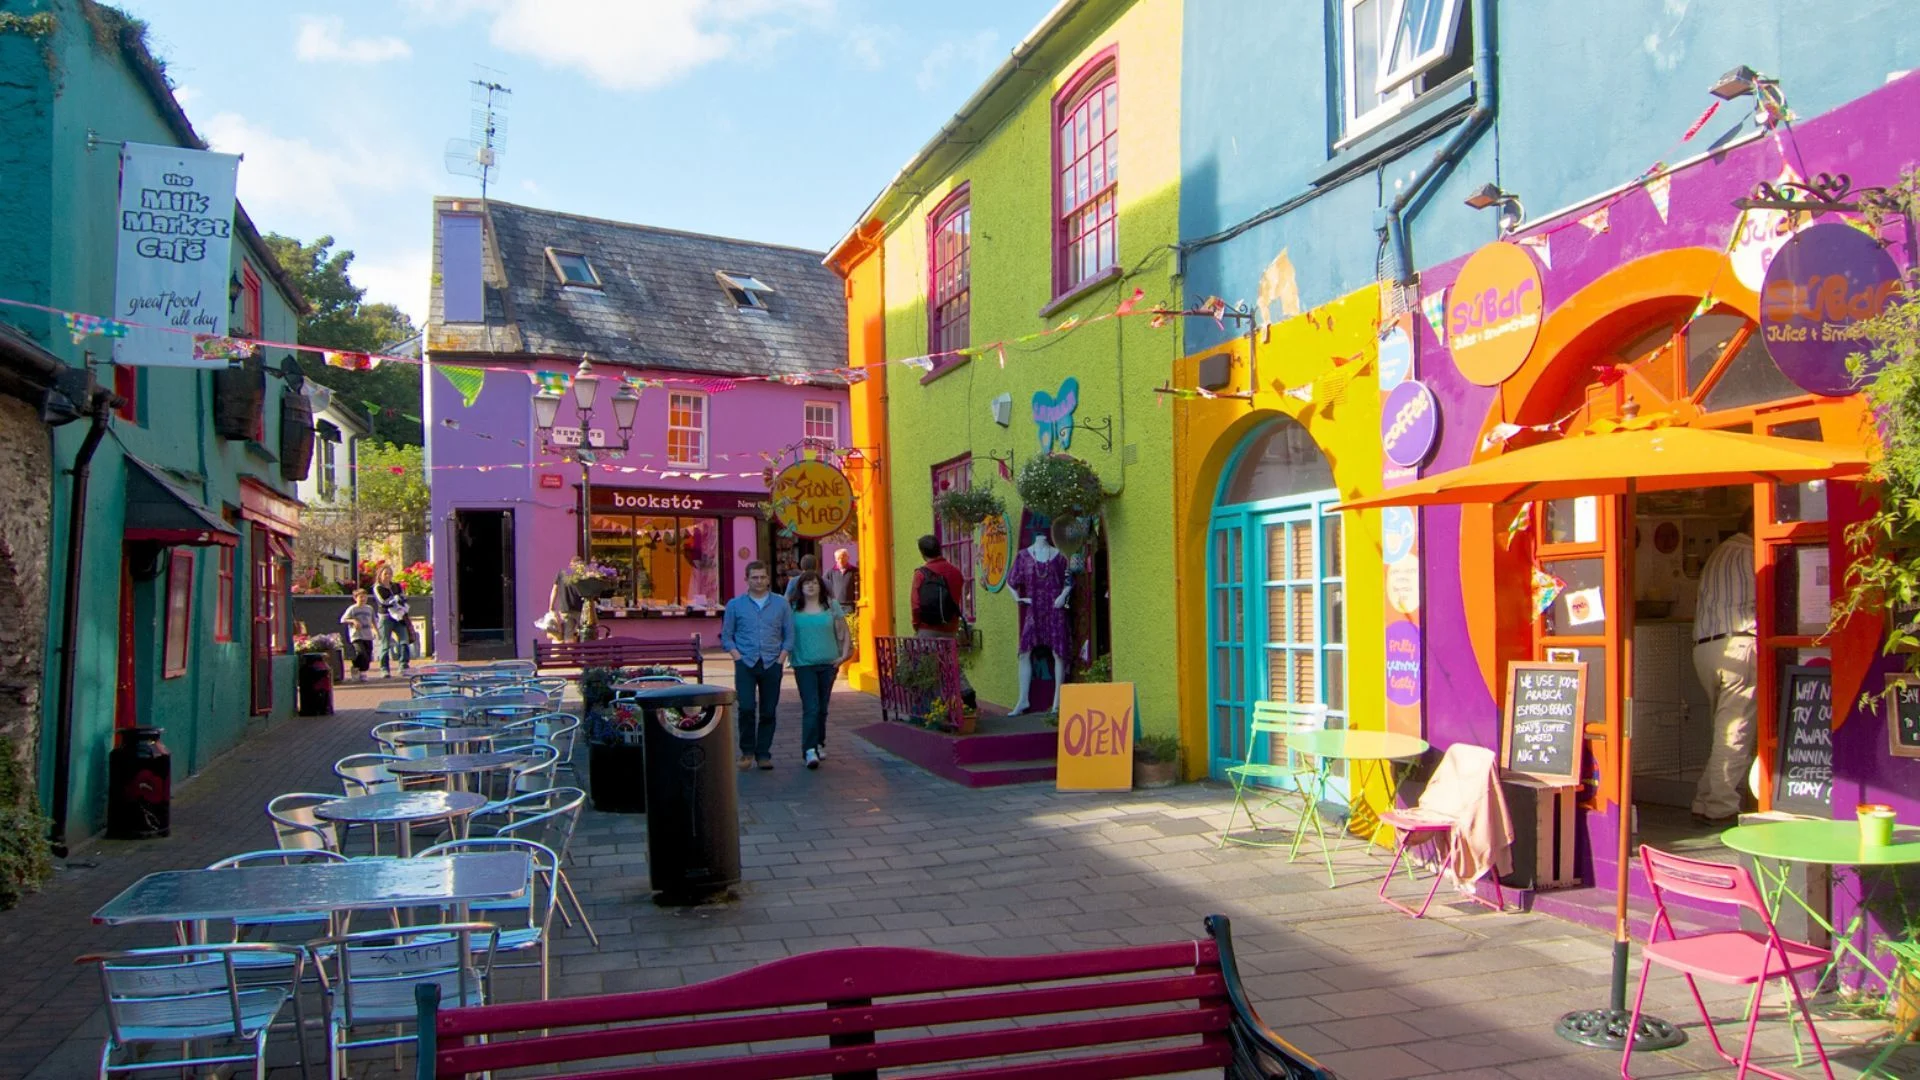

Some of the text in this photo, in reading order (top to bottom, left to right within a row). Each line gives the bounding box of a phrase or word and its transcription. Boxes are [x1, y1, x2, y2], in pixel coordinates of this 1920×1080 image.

[163, 174, 194, 187] the
[142, 189, 209, 214] Milk
[123, 211, 230, 238] Market
[137, 237, 206, 263] Café
[124, 291, 201, 316] great food
[171, 309, 218, 333] all day
[1767, 324, 1807, 342] Juice
[613, 492, 703, 510] bookstór
[737, 500, 756, 508] New
[796, 505, 844, 525] MAD
[1535, 675, 1555, 687] USE
[1796, 681, 1819, 701] WHY
[1525, 689, 1562, 701] ARABICA
[1549, 703, 1573, 716] BEANS
[1793, 706, 1813, 724] TRY
[1064, 705, 1132, 756] OPEN
